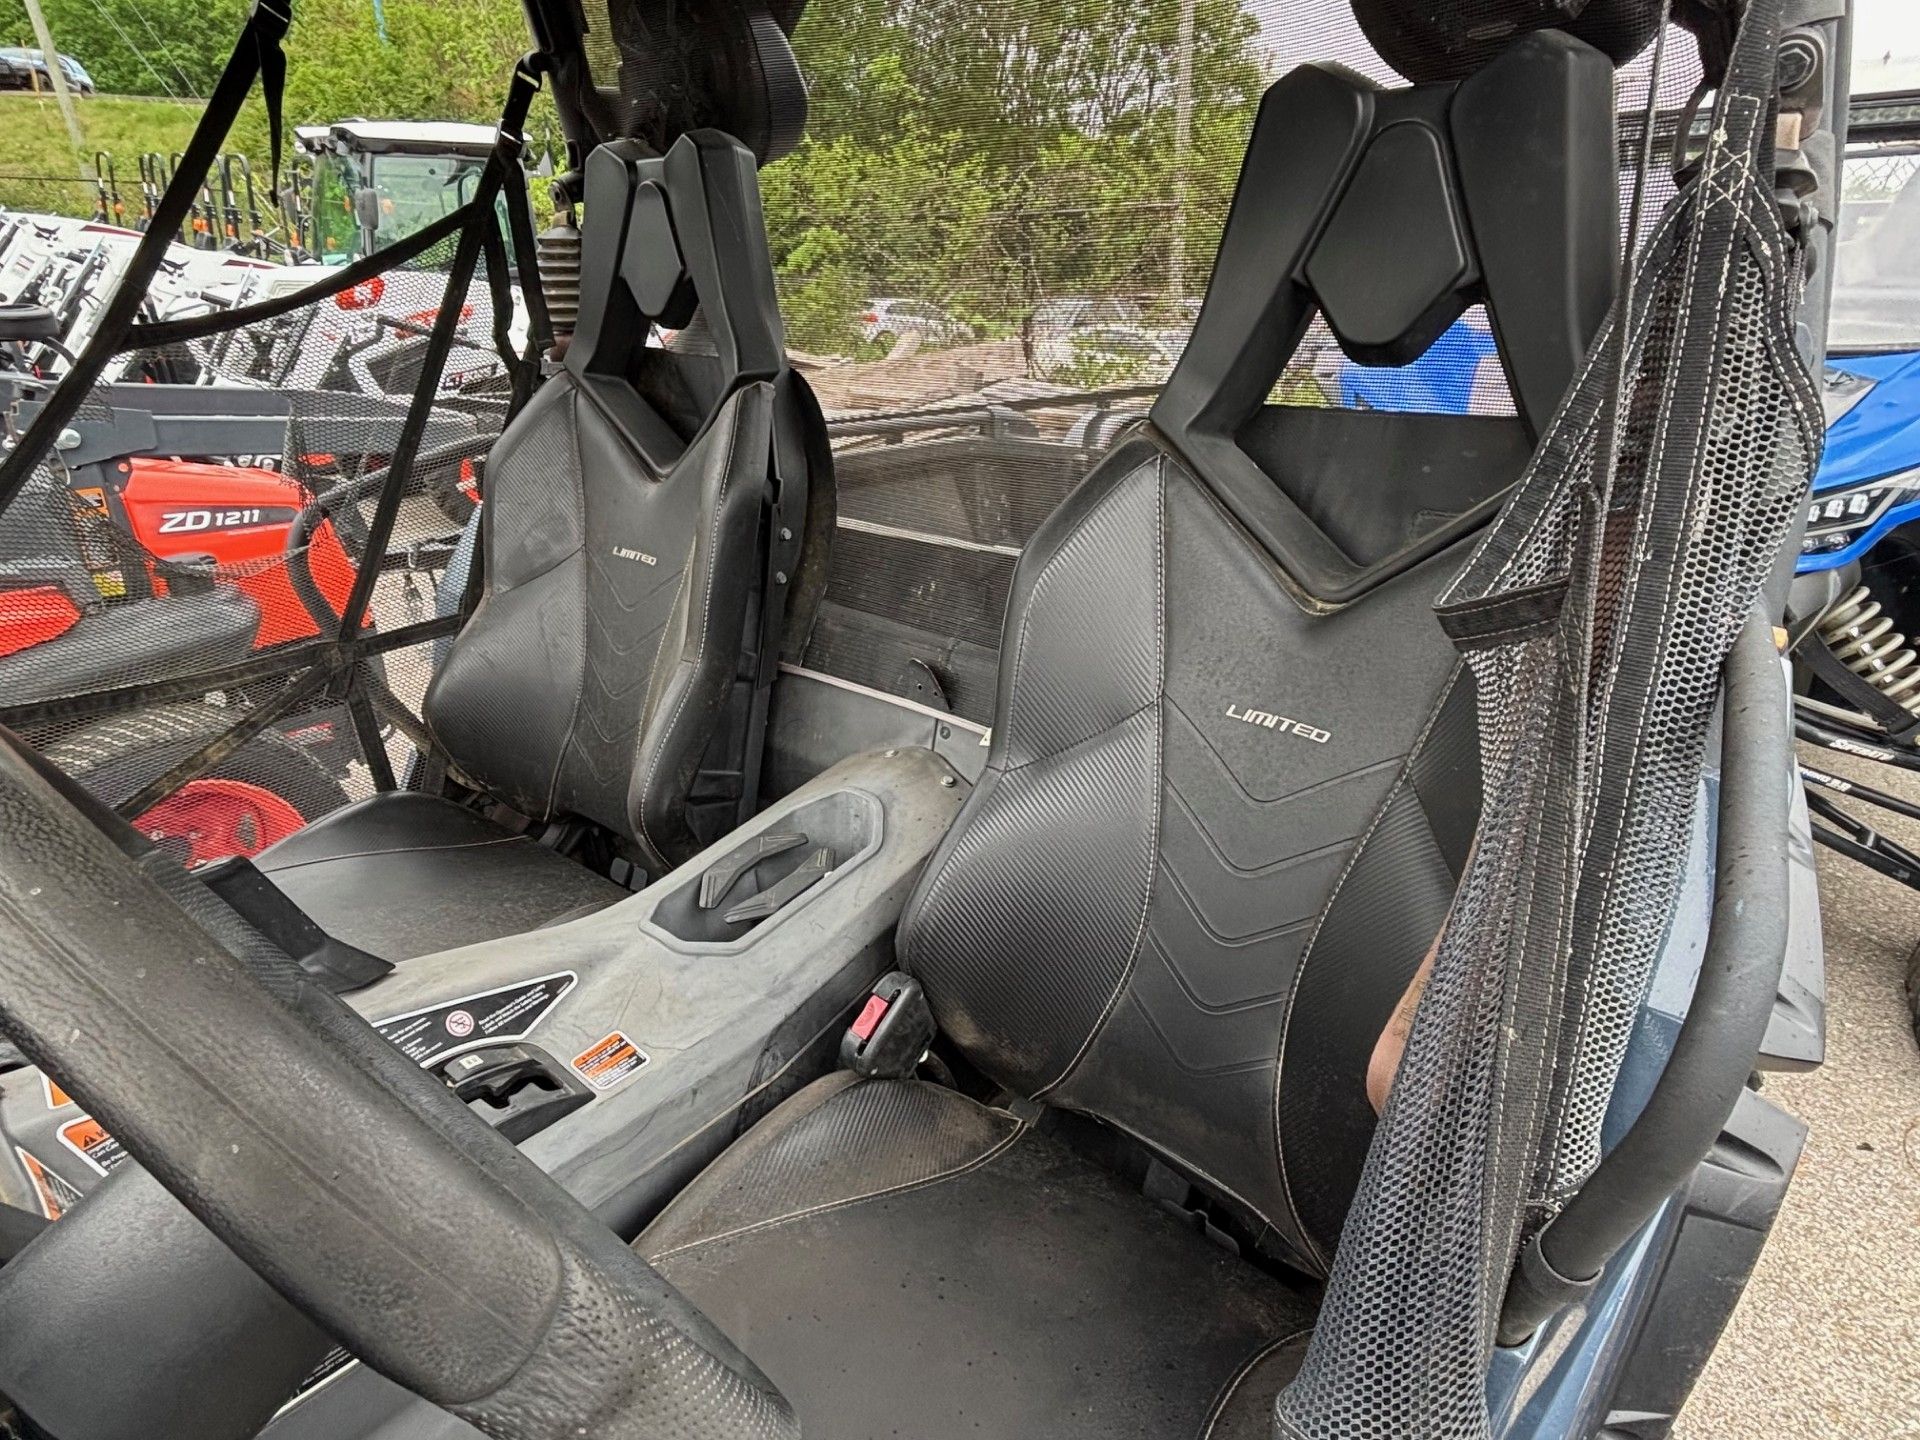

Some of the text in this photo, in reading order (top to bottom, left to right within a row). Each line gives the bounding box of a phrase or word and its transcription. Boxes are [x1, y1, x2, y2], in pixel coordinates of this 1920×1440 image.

[159, 509, 260, 534] ZD 1211
[612, 546, 657, 566] LIMITED
[1225, 704, 1332, 743] LIMITED
